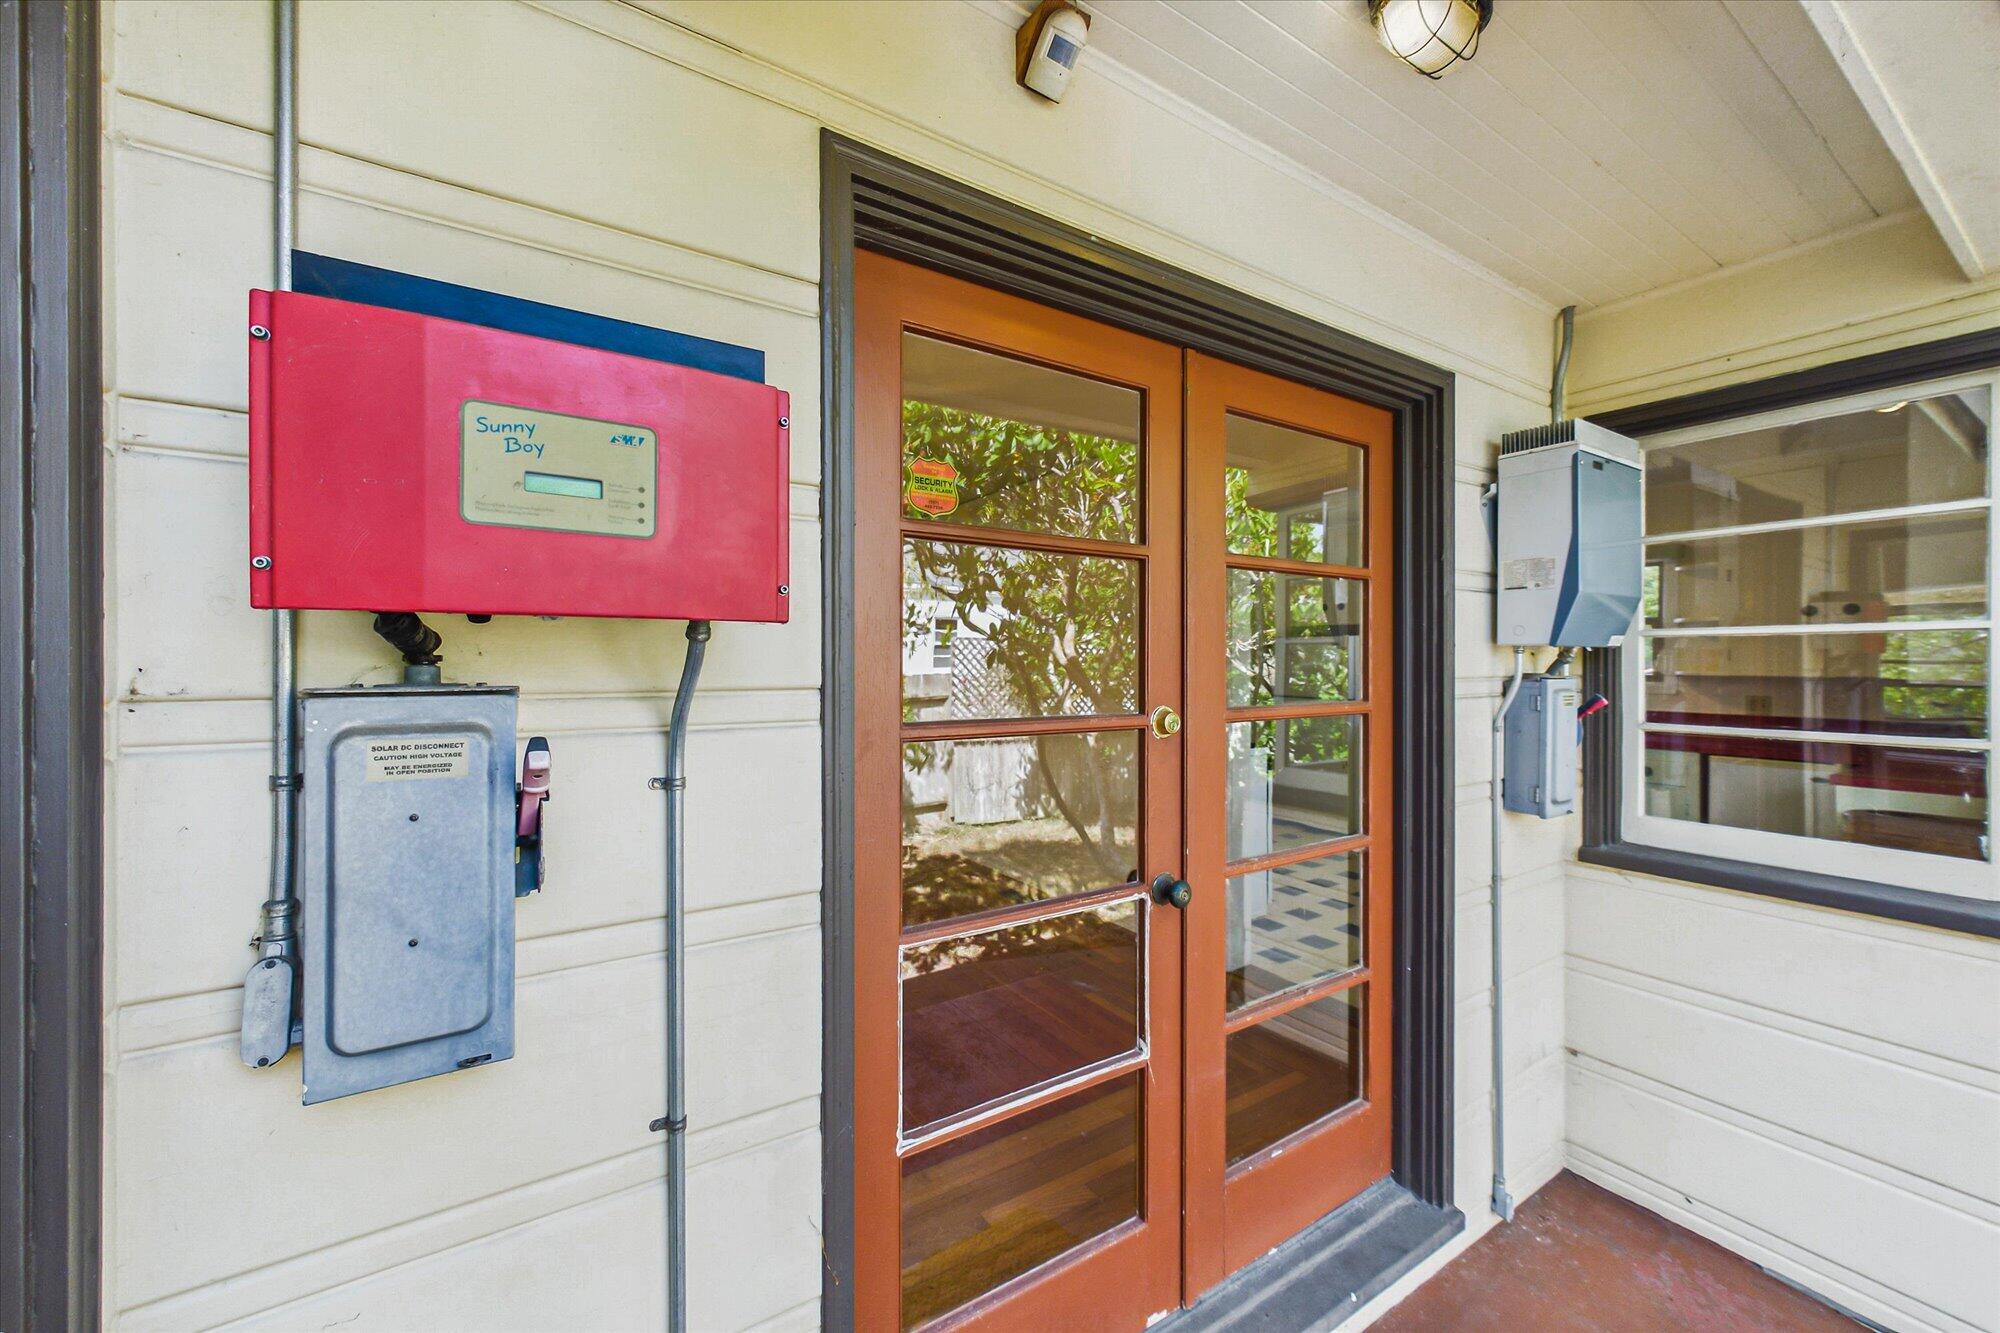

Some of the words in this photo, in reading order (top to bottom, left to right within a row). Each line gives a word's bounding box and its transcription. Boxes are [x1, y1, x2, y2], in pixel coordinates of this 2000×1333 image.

[476, 416, 536, 439] Sunny
[503, 436, 545, 459] Boy
[914, 476, 953, 489] SECURITY
